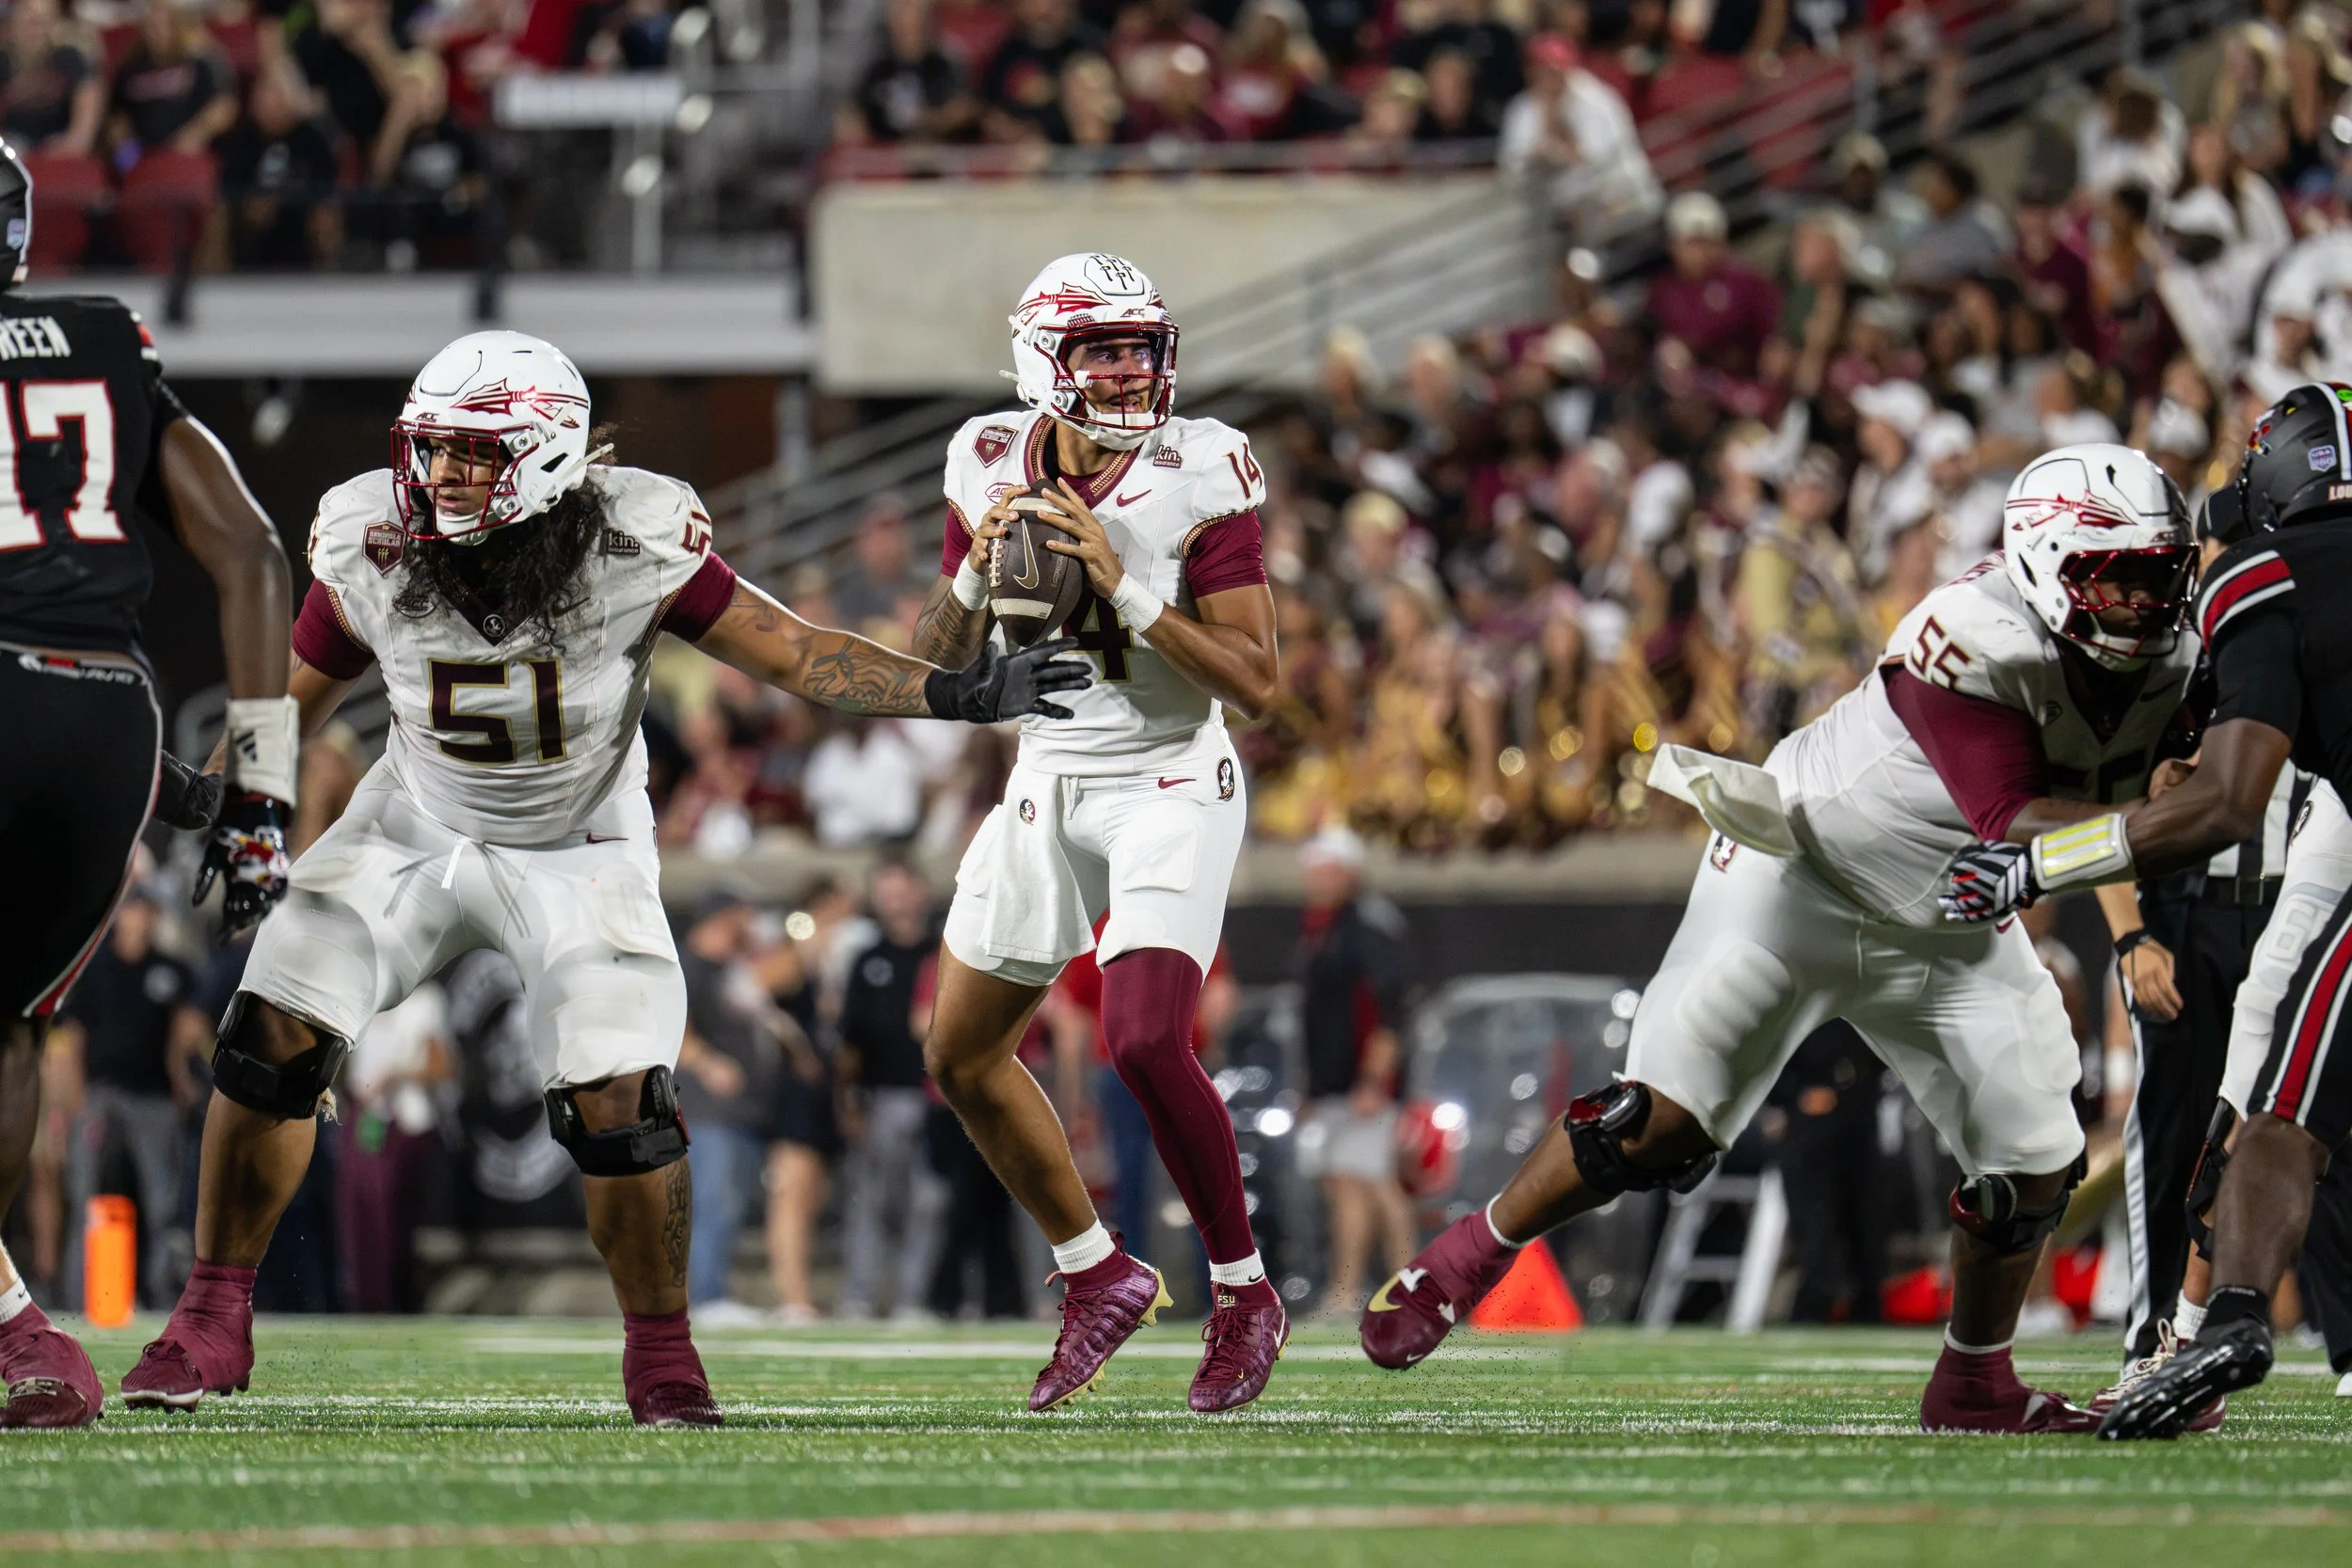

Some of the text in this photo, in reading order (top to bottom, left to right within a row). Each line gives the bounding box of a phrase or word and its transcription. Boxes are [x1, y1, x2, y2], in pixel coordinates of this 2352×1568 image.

[1120, 308, 1145, 318] ACC
[415, 412, 439, 423] ACC
[0, 378, 129, 552] 17
[1223, 441, 1263, 500] 14
[609, 531, 639, 547] kin.
[1054, 555, 1136, 684] 4
[427, 657, 568, 768] 51
[1217, 1294, 1236, 1304] FSU
